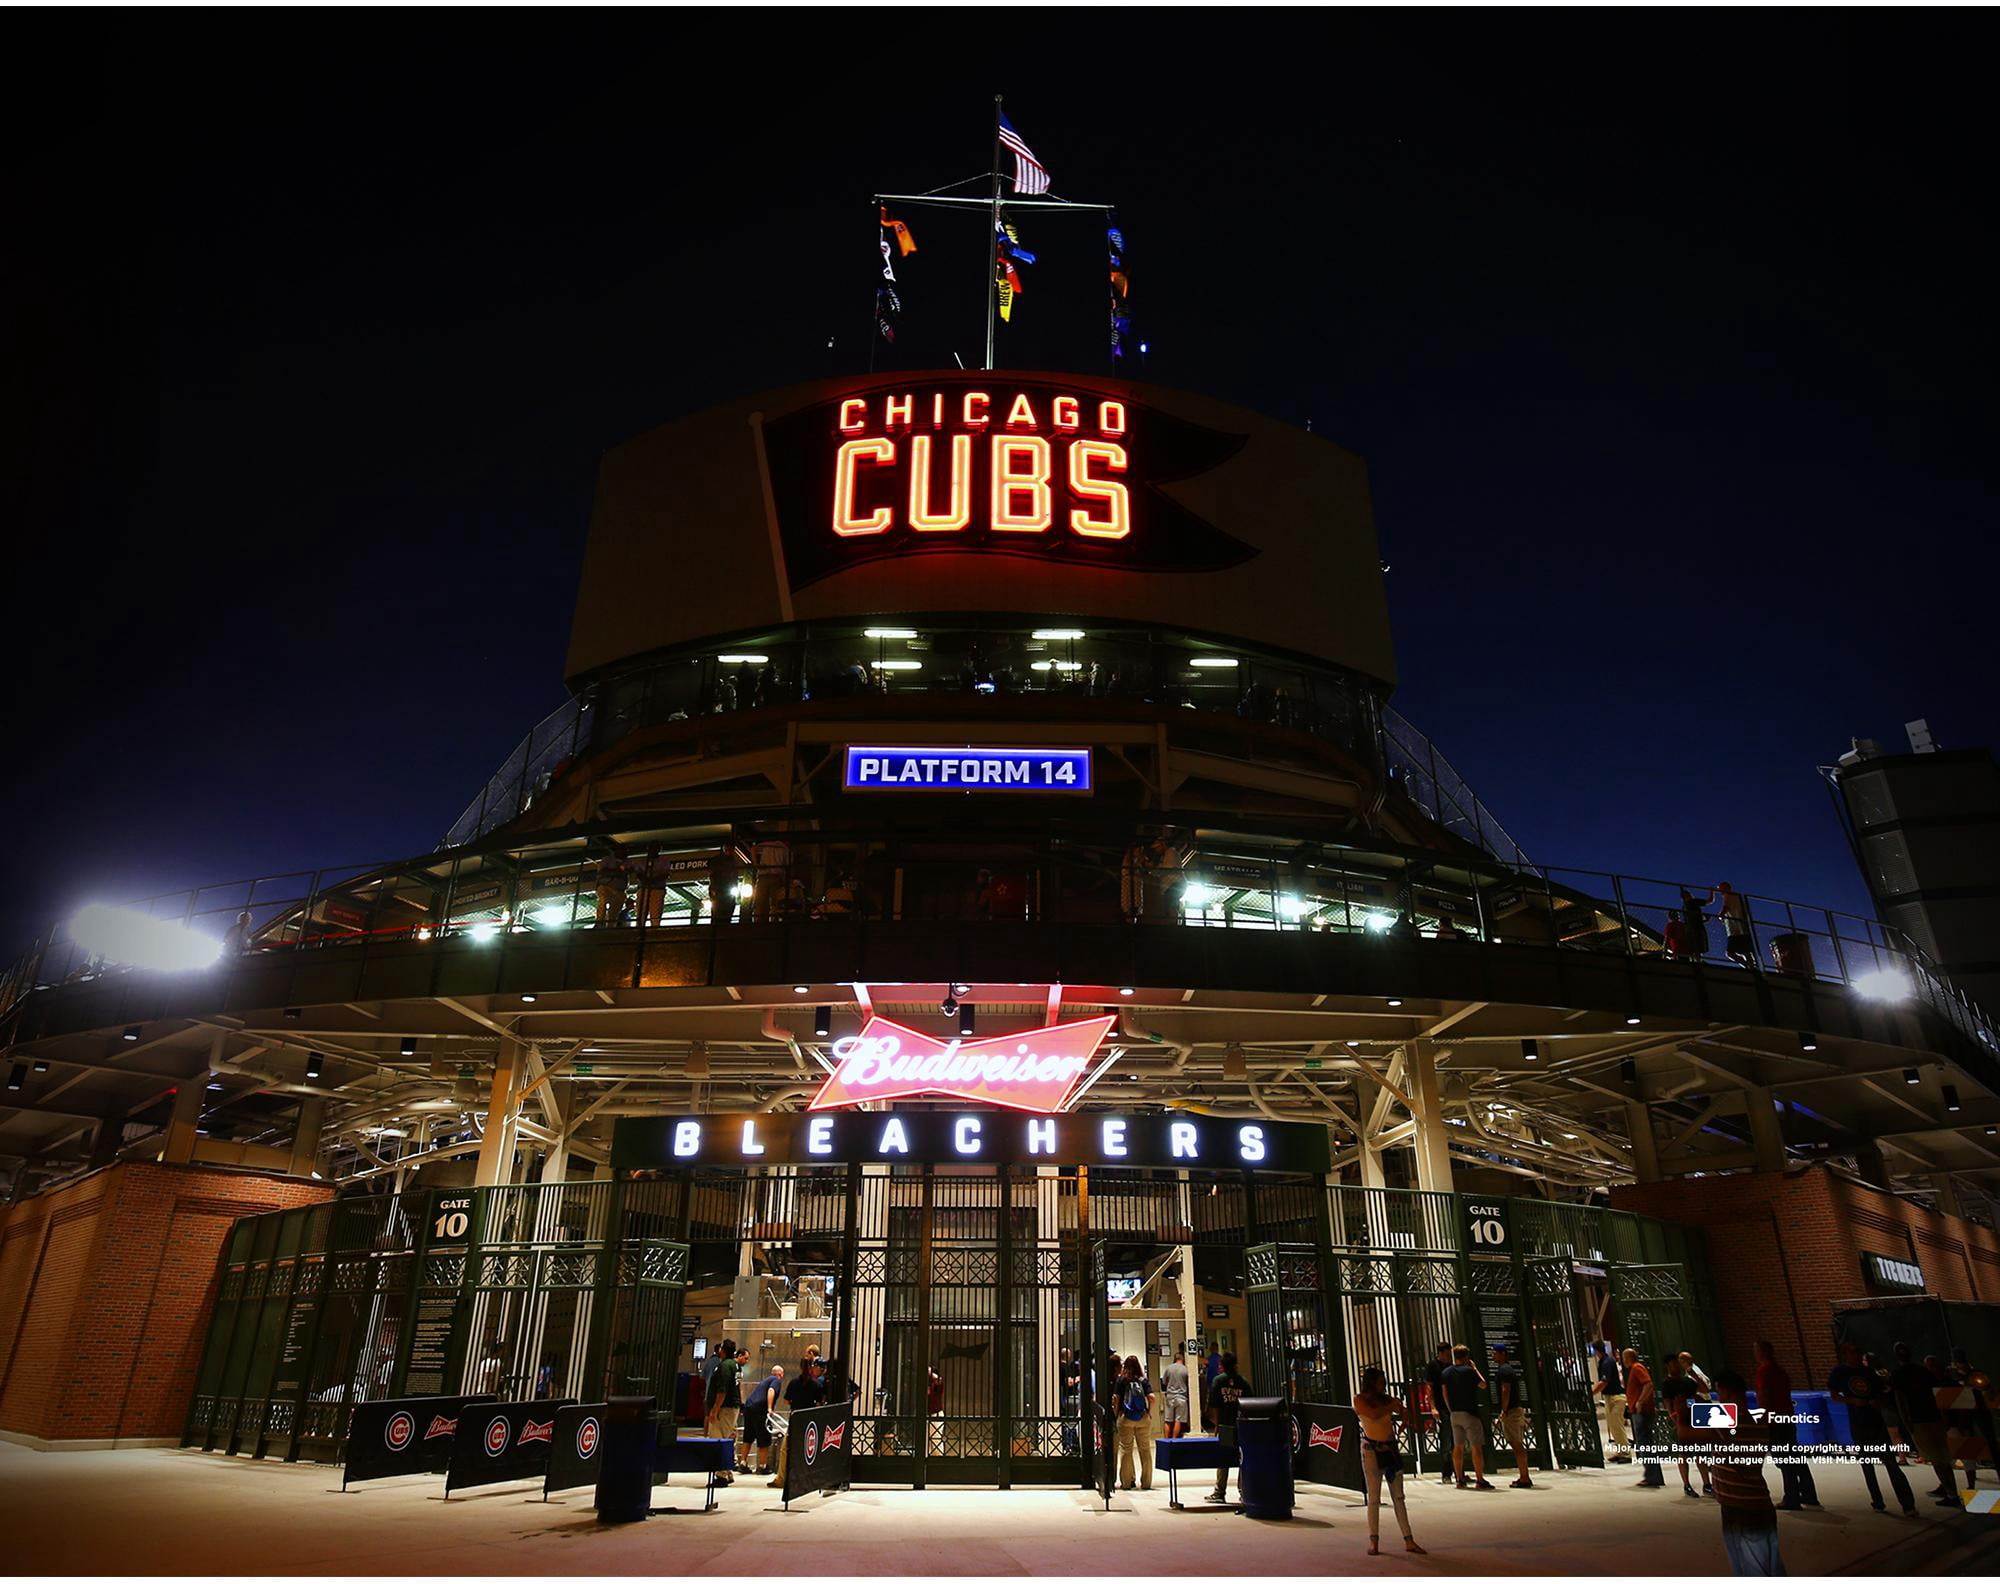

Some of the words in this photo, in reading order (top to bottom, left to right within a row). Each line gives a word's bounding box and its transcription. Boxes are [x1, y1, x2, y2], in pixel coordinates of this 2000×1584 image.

[838, 391, 1128, 434] CHICAGO
[832, 433, 1132, 540] CUBS
[859, 758, 1030, 783] PLATFORM
[1040, 761, 1077, 784] 14
[832, 1035, 1087, 1086] Budweiser
[673, 1117, 1266, 1161] BLEACHERS
[440, 1199, 471, 1209] GATE
[1469, 1205, 1501, 1217] GATE
[435, 1212, 469, 1238] 10
[1470, 1219, 1505, 1245] 10
